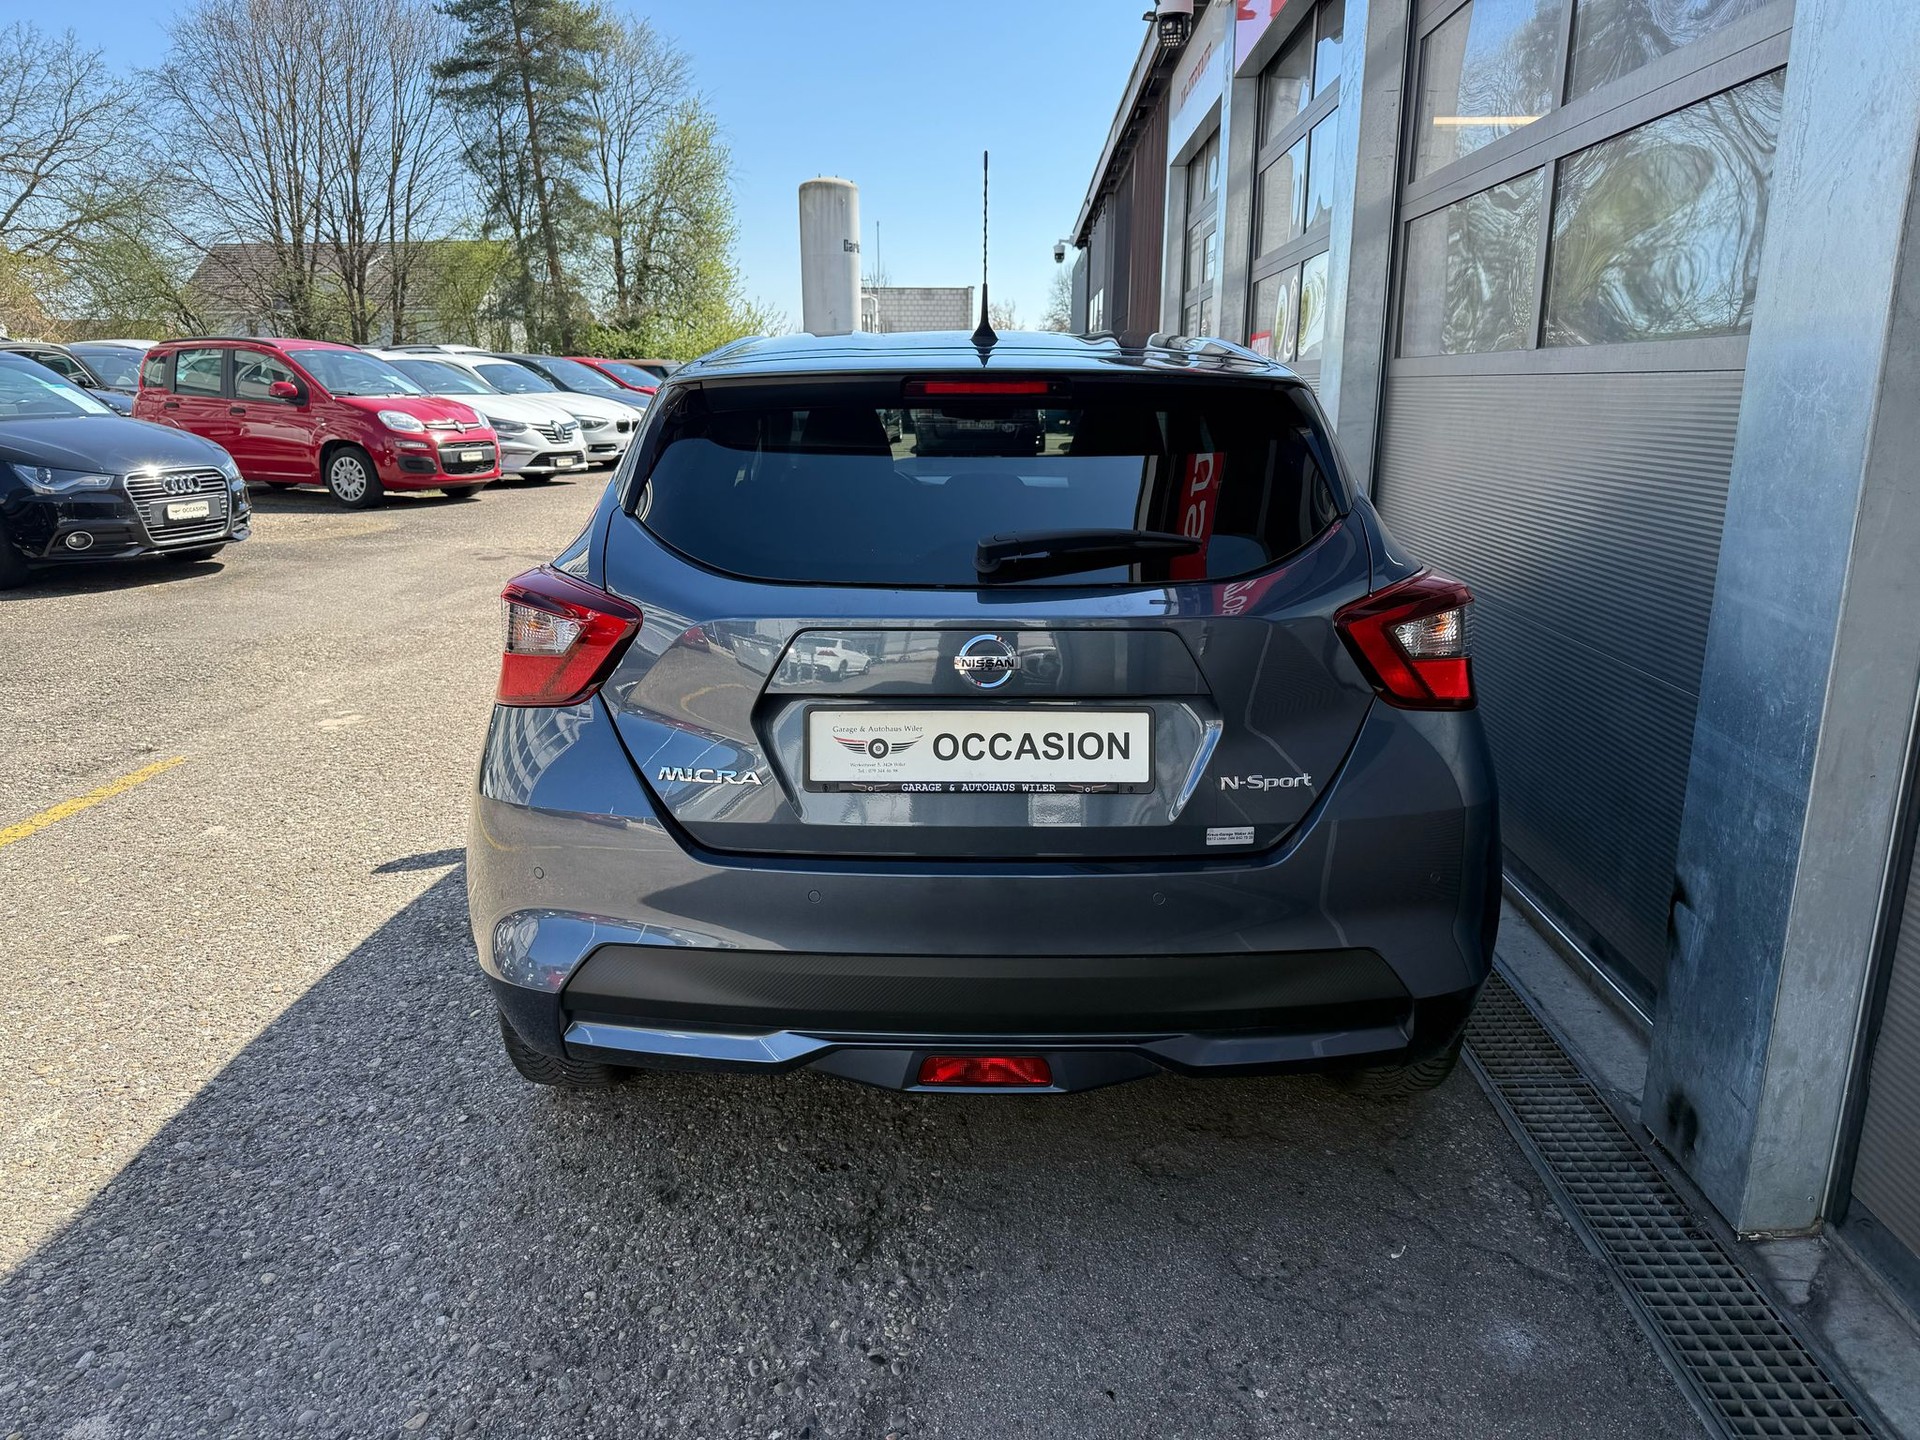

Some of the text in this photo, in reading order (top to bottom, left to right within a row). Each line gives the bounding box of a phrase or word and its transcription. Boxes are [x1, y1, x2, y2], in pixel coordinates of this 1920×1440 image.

[961, 659, 1015, 668] NISSAN
[832, 725, 858, 735] Garage
[868, 725, 902, 733] Autohaus
[904, 724, 924, 732] Wiler
[932, 732, 1130, 760] OCCASION
[658, 766, 763, 785] MICRA
[1220, 773, 1313, 792] N-Sport
[901, 783, 1057, 792] GARAGE & AUTOHAUS WILER
